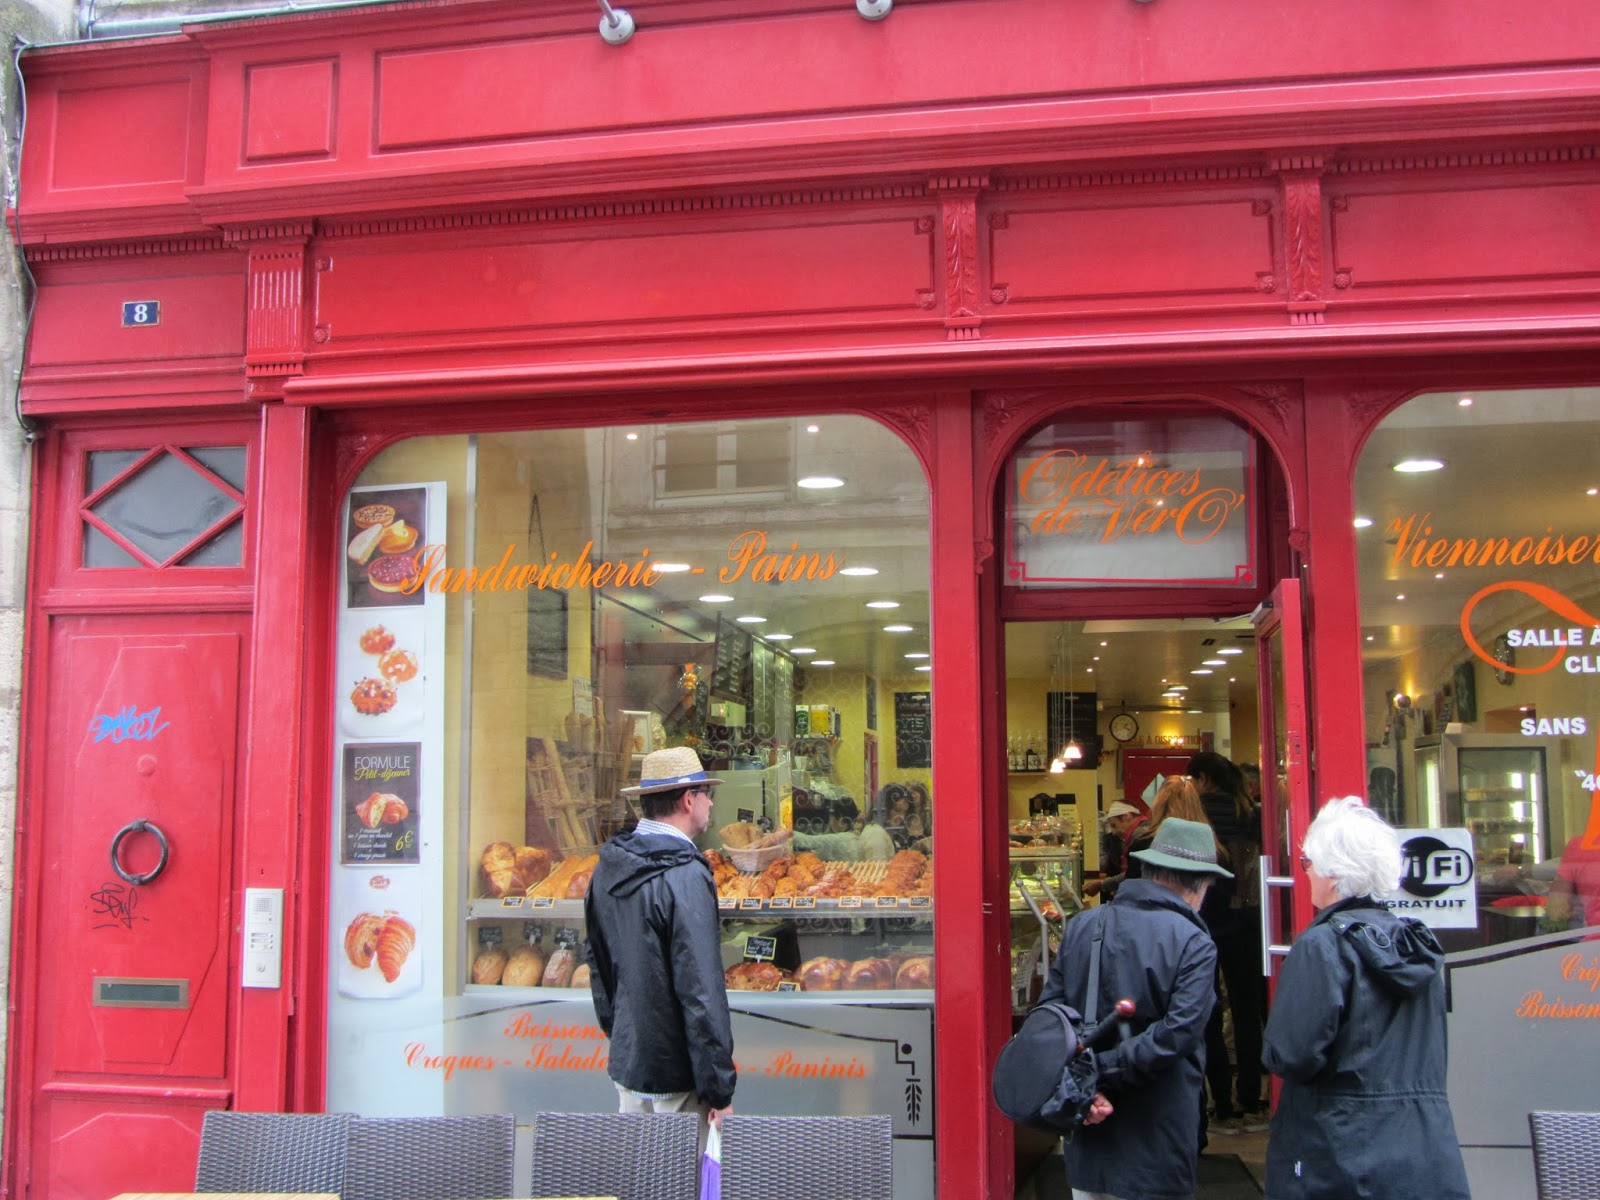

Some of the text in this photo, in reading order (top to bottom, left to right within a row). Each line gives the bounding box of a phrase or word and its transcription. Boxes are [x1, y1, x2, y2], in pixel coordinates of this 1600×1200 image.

[133, 303, 148, 323] 8
[1031, 495, 1083, 534] de
[400, 540, 664, 595] Sandwicherie
[719, 529, 848, 584] Pains
[1507, 629, 1583, 647] SALLE
[1520, 717, 1587, 736] SANS
[354, 755, 411, 769] FORMULE
[1385, 899, 1466, 909] GRATUIT
[403, 1041, 496, 1080] Croques
[764, 1048, 868, 1079] Paninis
